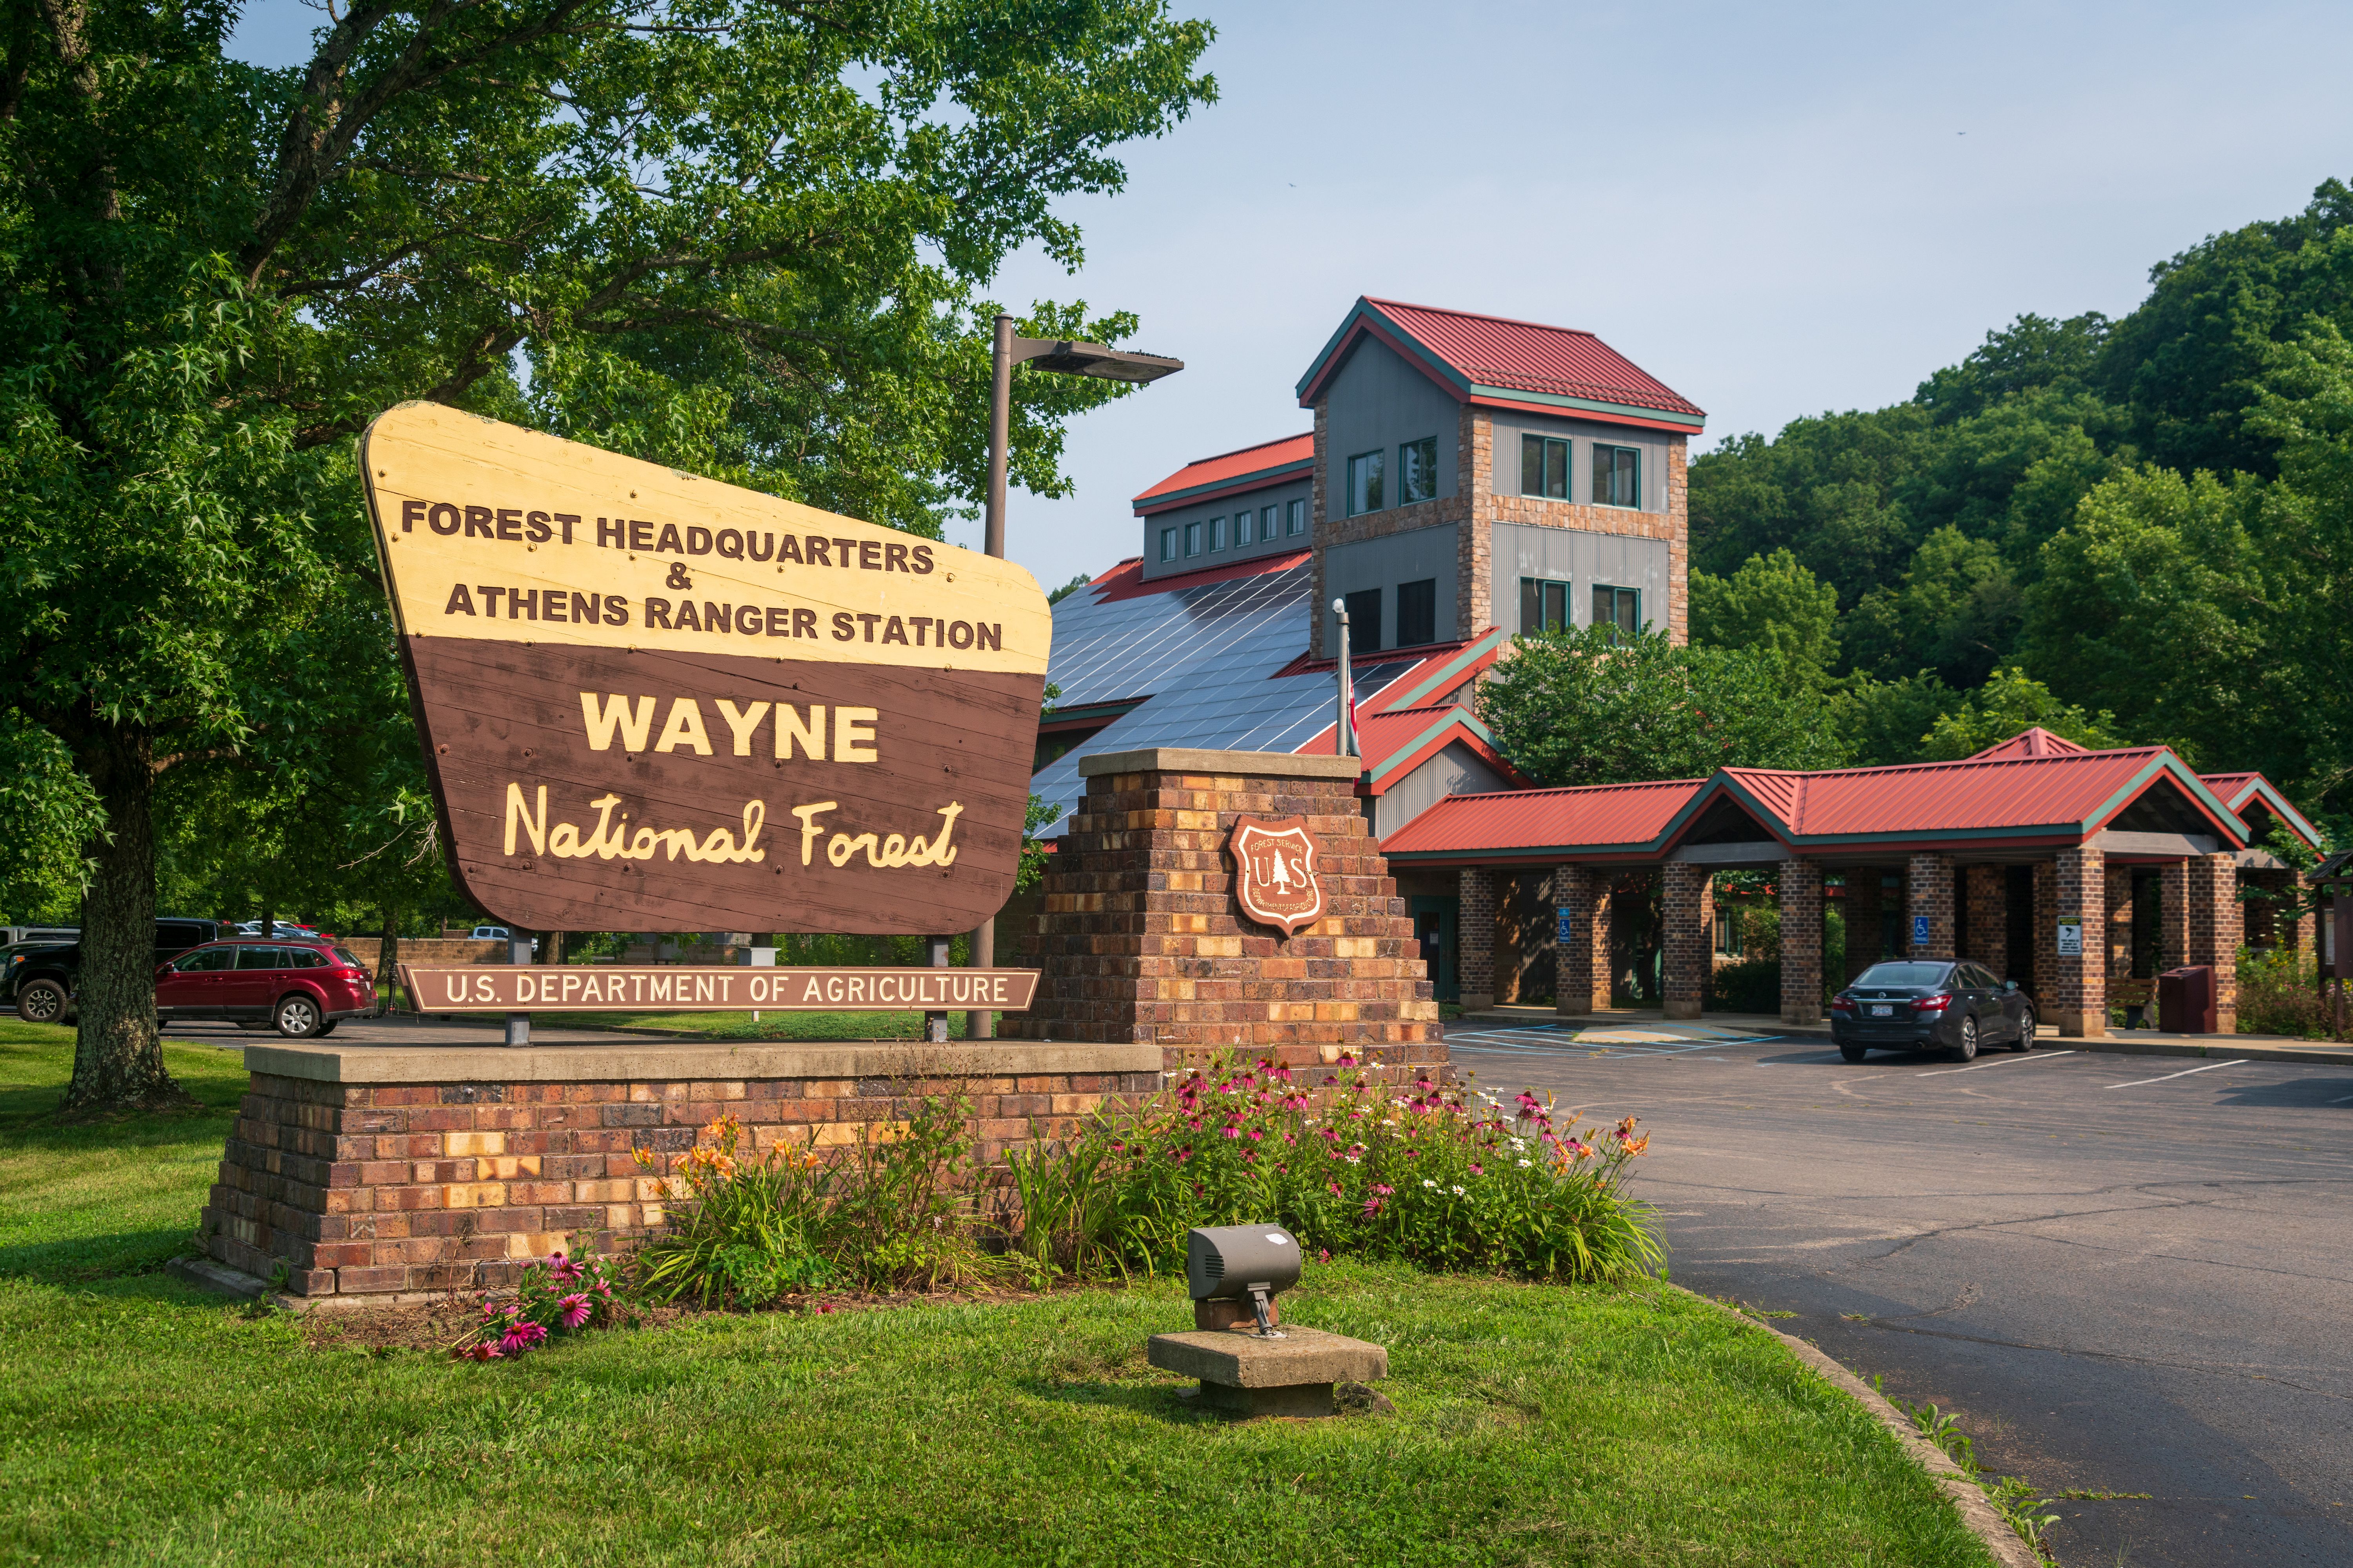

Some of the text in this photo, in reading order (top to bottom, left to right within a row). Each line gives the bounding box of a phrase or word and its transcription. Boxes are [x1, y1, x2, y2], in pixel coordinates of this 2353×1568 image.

[402, 500, 934, 575] FOREST HEADQUARTERS
[666, 562, 693, 591] &
[444, 583, 1002, 651] ATHENS RANGER STATION
[580, 692, 878, 763] WAYNE
[504, 782, 964, 868] National Forest
[1251, 839, 1303, 854] FOREST SERVICE
[1253, 888, 1282, 910] DEPARTMENT
[1289, 889, 1314, 911] AGRICULTURE
[447, 973, 1009, 1003] U.S. DEPARTMENT OF AGRICULTURE
